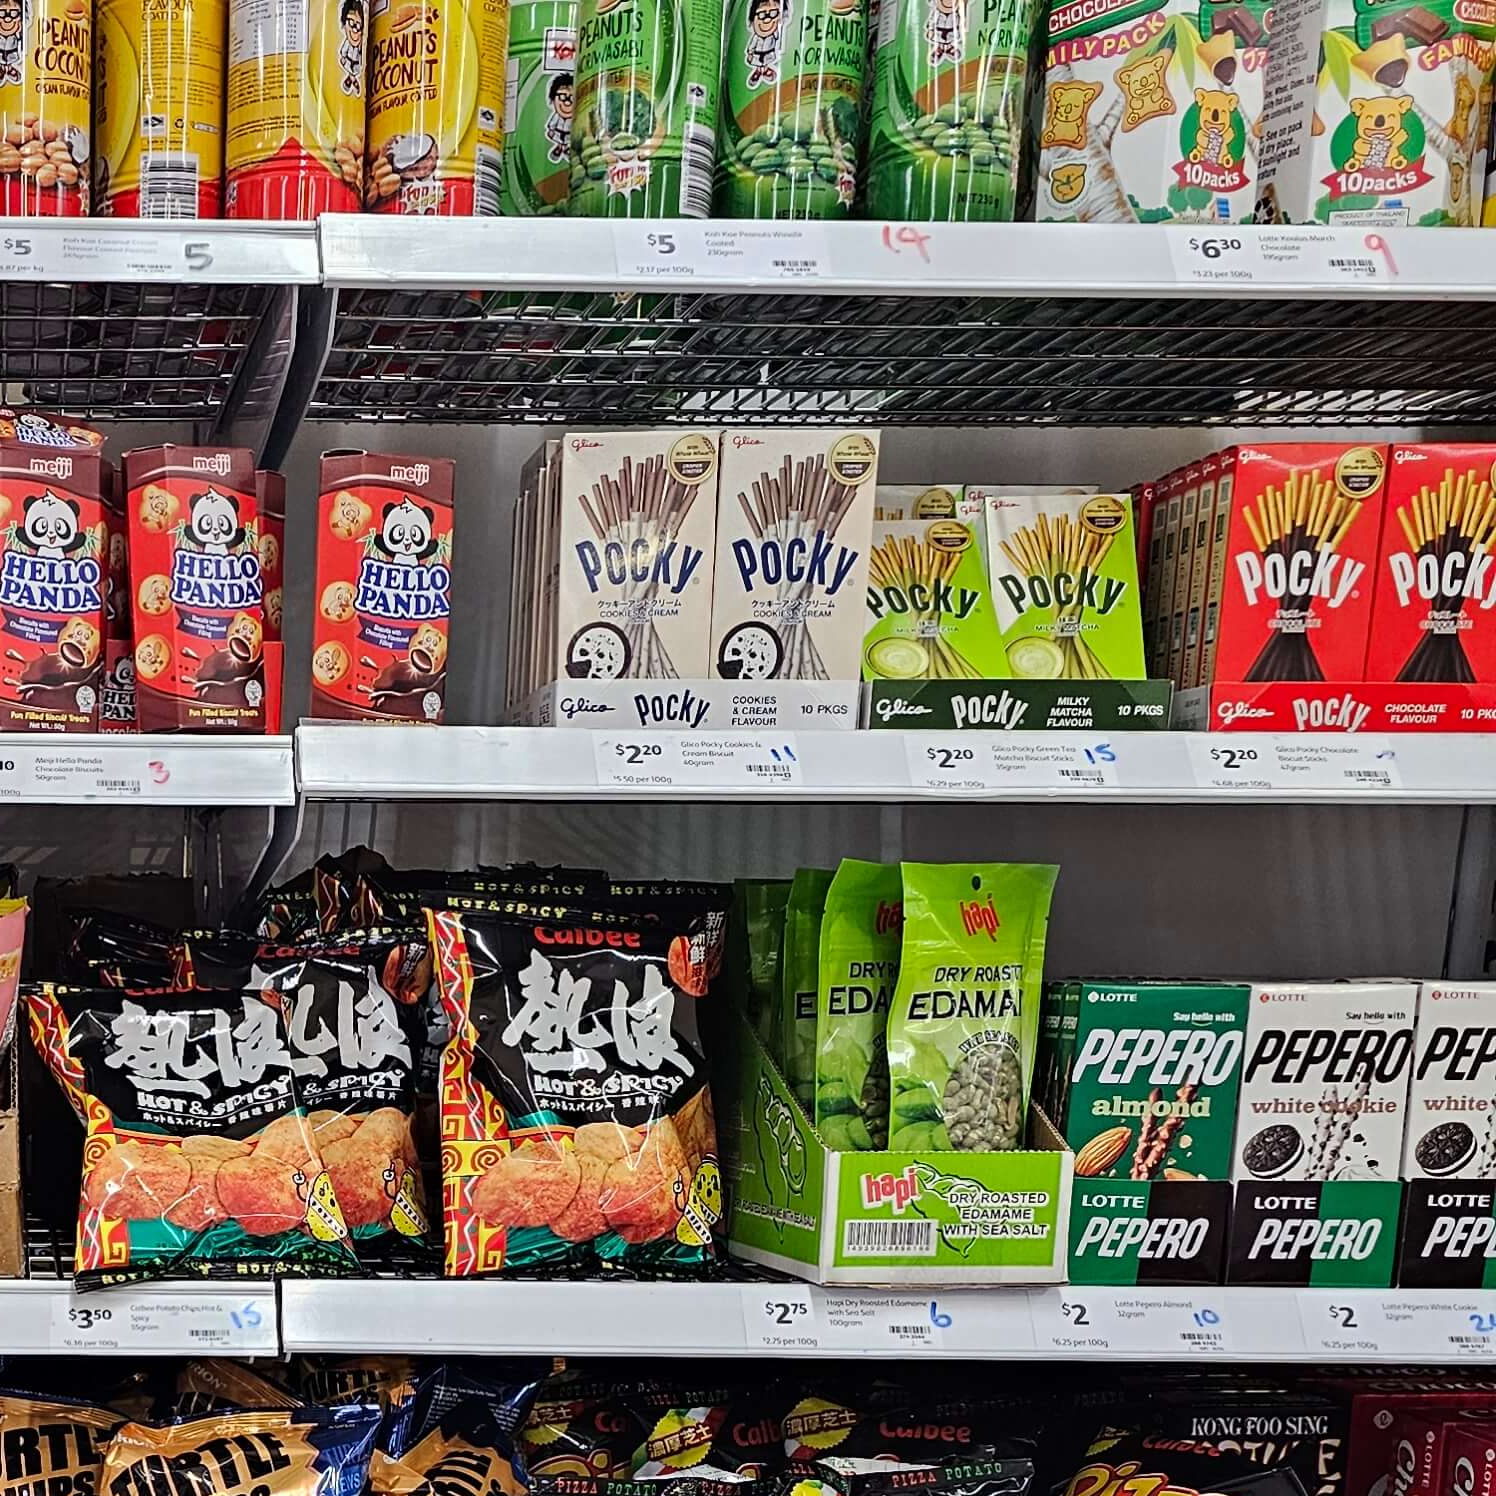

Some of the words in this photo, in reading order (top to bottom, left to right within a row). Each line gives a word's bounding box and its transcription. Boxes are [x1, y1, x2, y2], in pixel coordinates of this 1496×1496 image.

[1184, 168, 1241, 190] 10packs
[648, 234, 676, 254] $5
[1365, 234, 1400, 276] 9
[31, 458, 72, 478] meiji
[4, 557, 99, 585] HELLO
[1, 580, 102, 608] PANDA
[732, 695, 777, 705] COOKIES
[1057, 696, 1091, 707] MILKY
[732, 707, 739, 716] &
[742, 706, 777, 716] CREAM
[801, 704, 813, 715] 10
[816, 703, 848, 715] PKGS
[1050, 707, 1093, 717] MATCHA
[1384, 704, 1447, 714] CHOCOLATE
[732, 717, 777, 726] FLAVOUR
[1047, 718, 1094, 728] FLAVOUR
[1391, 714, 1438, 724] FLAVOUR
[1072, 1029, 1244, 1085] PEPERO
[1091, 1096, 1211, 1117] almond
[949, 1192, 977, 1205] DRY
[980, 1192, 1047, 1205] ROASTED
[1081, 1194, 1145, 1209] LOTTE
[961, 1208, 1031, 1220] EDAMAME
[943, 1224, 979, 1237] WITH
[982, 1224, 1006, 1237] SEA
[1009, 1224, 1047, 1237] SALT
[1075, 1217, 1208, 1260] PEPERO
[1062, 1302, 1090, 1325] $2
[1191, 1417, 1242, 1436] KONG
[1246, 1417, 1280, 1435] FOO
[1285, 1416, 1328, 1435] SING
[892, 1471, 936, 1488] PIZZA
[945, 1462, 1002, 1480] POTATO
